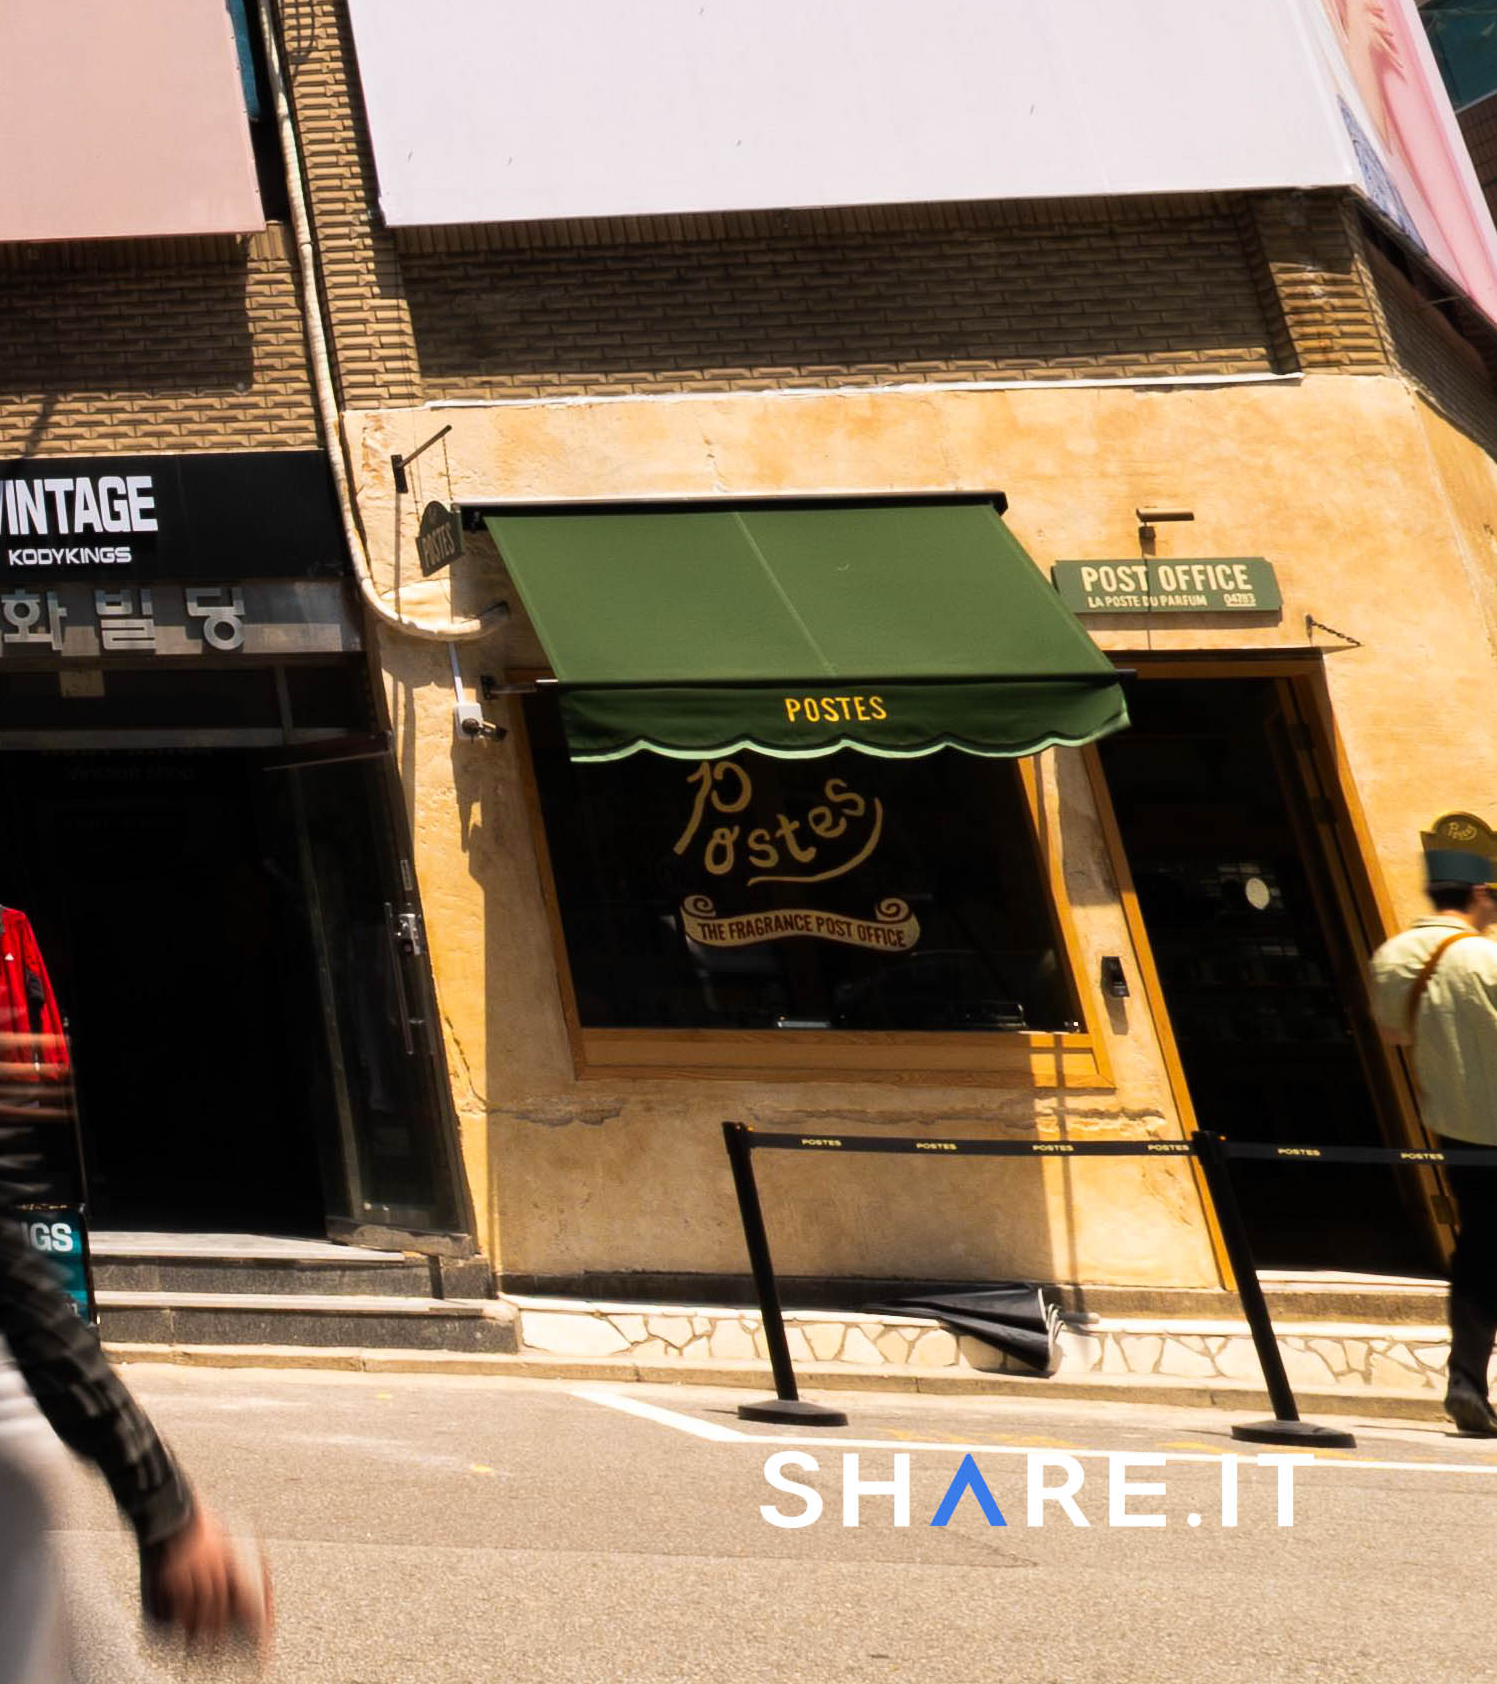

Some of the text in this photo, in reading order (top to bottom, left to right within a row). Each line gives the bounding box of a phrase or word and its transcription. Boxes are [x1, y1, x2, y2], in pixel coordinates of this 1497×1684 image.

[8, 546, 133, 567] KODYKINGS
[1080, 564, 1254, 593] POST OFFICE
[1088, 594, 1208, 608] LA POSTE DU PARFUM
[784, 695, 888, 723] POSTES
[673, 761, 882, 886] Postes
[697, 914, 907, 949] THE FRAGRANCE POST OFFICE
[801, 1138, 842, 1147] POSTES
[915, 1142, 959, 1151] POSTES
[1031, 1144, 1075, 1152] POSTES
[1147, 1143, 1190, 1152] POSTES
[1277, 1148, 1321, 1157] POSTES
[1400, 1152, 1444, 1161] POSTES
[21, 1221, 74, 1253] GS
